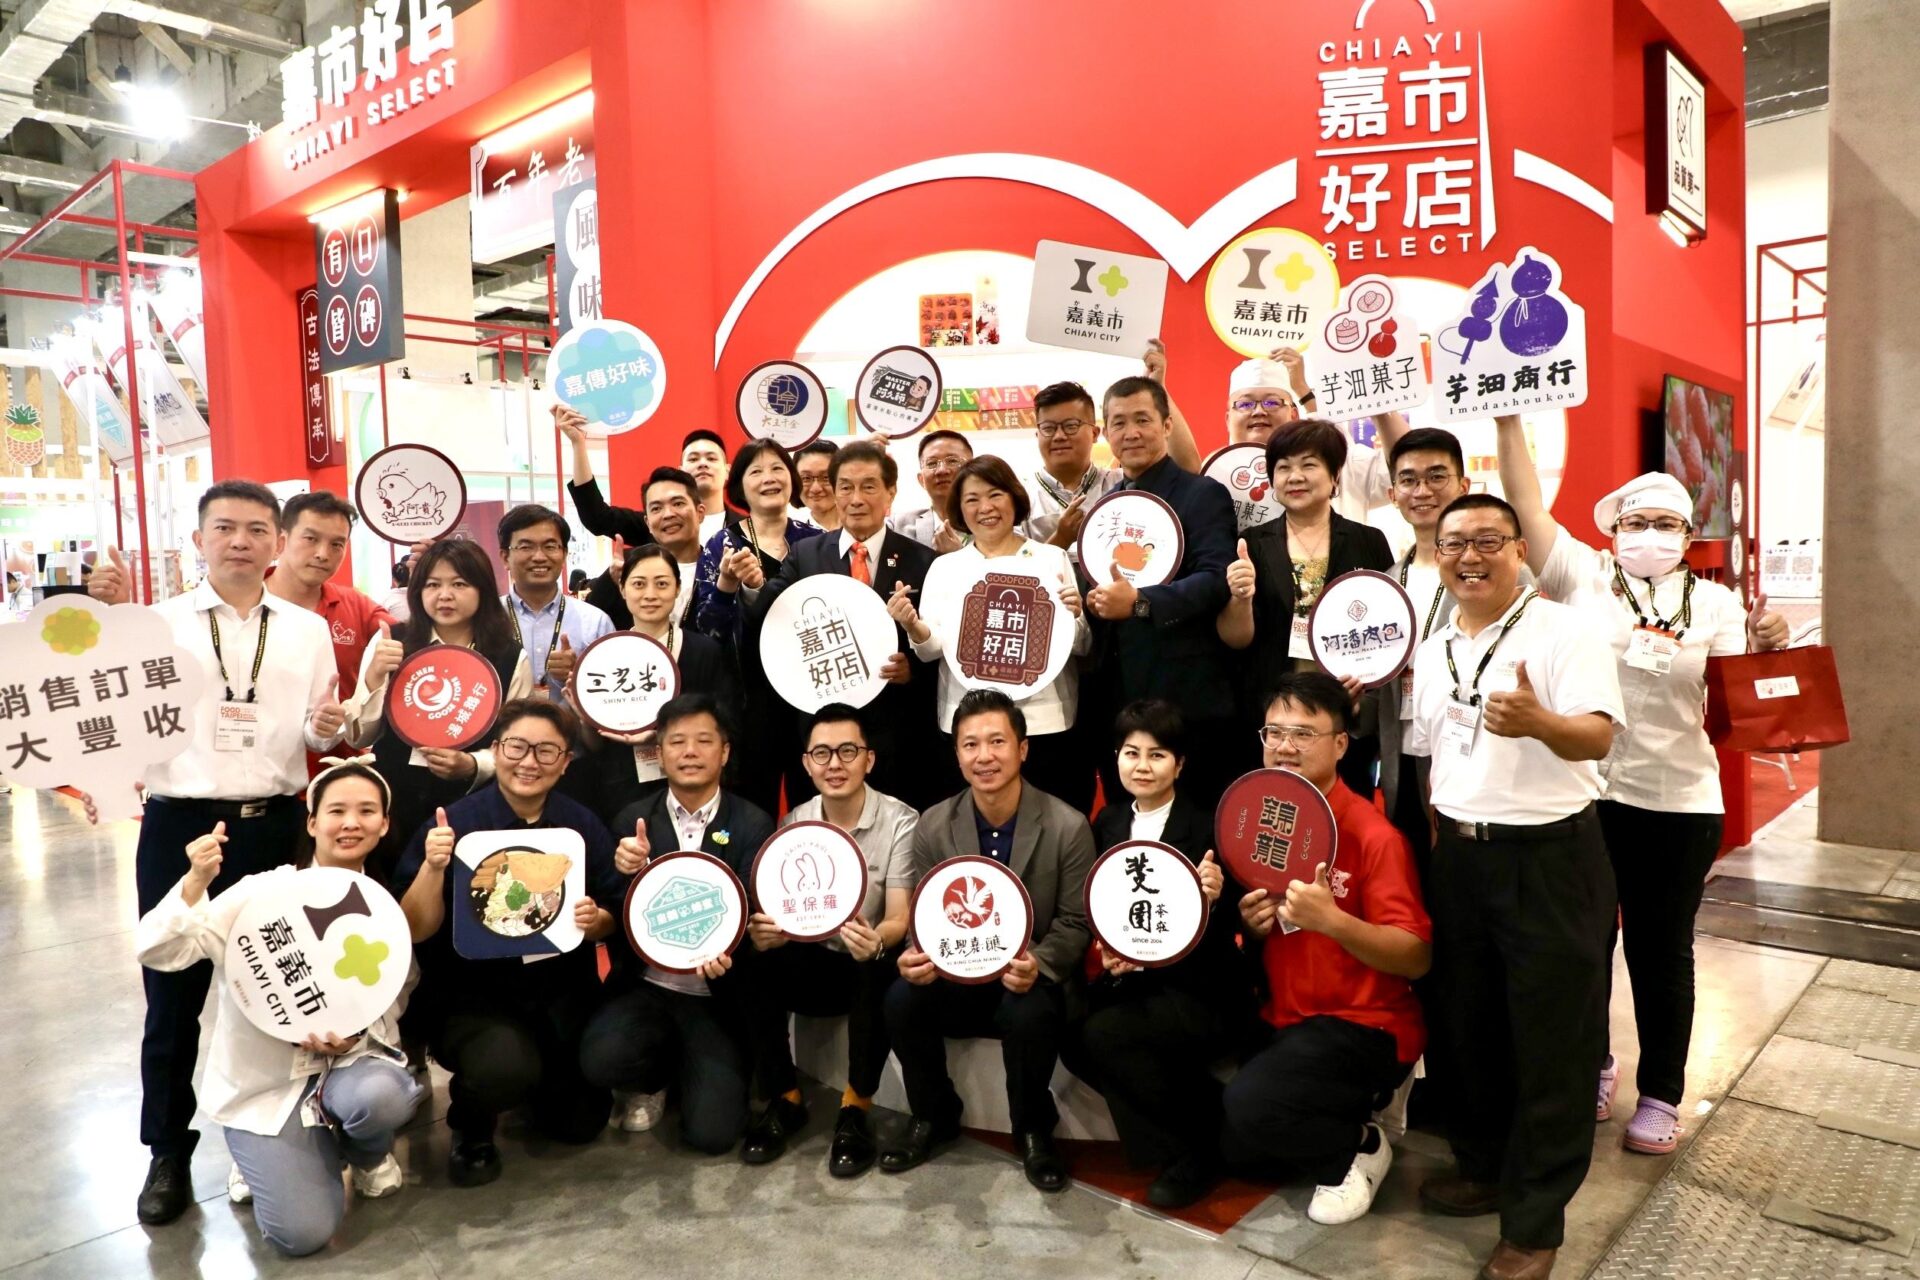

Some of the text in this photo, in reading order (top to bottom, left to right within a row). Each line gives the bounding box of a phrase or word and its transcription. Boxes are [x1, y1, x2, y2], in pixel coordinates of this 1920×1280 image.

[1318, 31, 1461, 63] CHIAYI
[367, 58, 456, 126] SELECT
[1318, 60, 1472, 140] 嘉市
[284, 116, 353, 169] CHIAYI
[1319, 156, 1474, 234] 好店
[1322, 232, 1474, 261] SELECT
[575, 201, 602, 320] 風味
[1066, 306, 1124, 330] 嘉義市
[1234, 299, 1309, 324] 嘉義市
[1064, 327, 1120, 342] CHIAYI CITY
[1231, 326, 1304, 341] CHIAYI CITY
[306, 312, 325, 442] 古法傳承
[563, 356, 652, 398] 嘉傳好味
[884, 375, 911, 386] MASTER
[885, 381, 905, 391] JIU
[1328, 393, 1417, 416] Imodagashi
[1449, 392, 1575, 415] Imodashoukou
[986, 574, 1039, 586] GOODFOOD
[989, 601, 1025, 610] CHIAYI
[793, 607, 840, 629] CHIAYI
[986, 608, 1026, 631] 嘉市
[796, 619, 847, 657] 嘉市
[983, 634, 1022, 658] 好店
[1320, 622, 1404, 652] 阿潘肉包
[808, 651, 860, 689] 好店
[981, 654, 1020, 665] SELECT
[0, 656, 181, 720] 銷售訂單
[403, 666, 434, 707] TOWN-CHEN
[816, 676, 864, 699] SELECT
[428, 703, 456, 720] GOOSE
[603, 697, 626, 705] SHINY
[782, 894, 838, 914] 聖保羅
[258, 916, 328, 1016] 嘉義市
[237, 934, 272, 989] CHIAYI
[266, 992, 292, 1027] CITY
